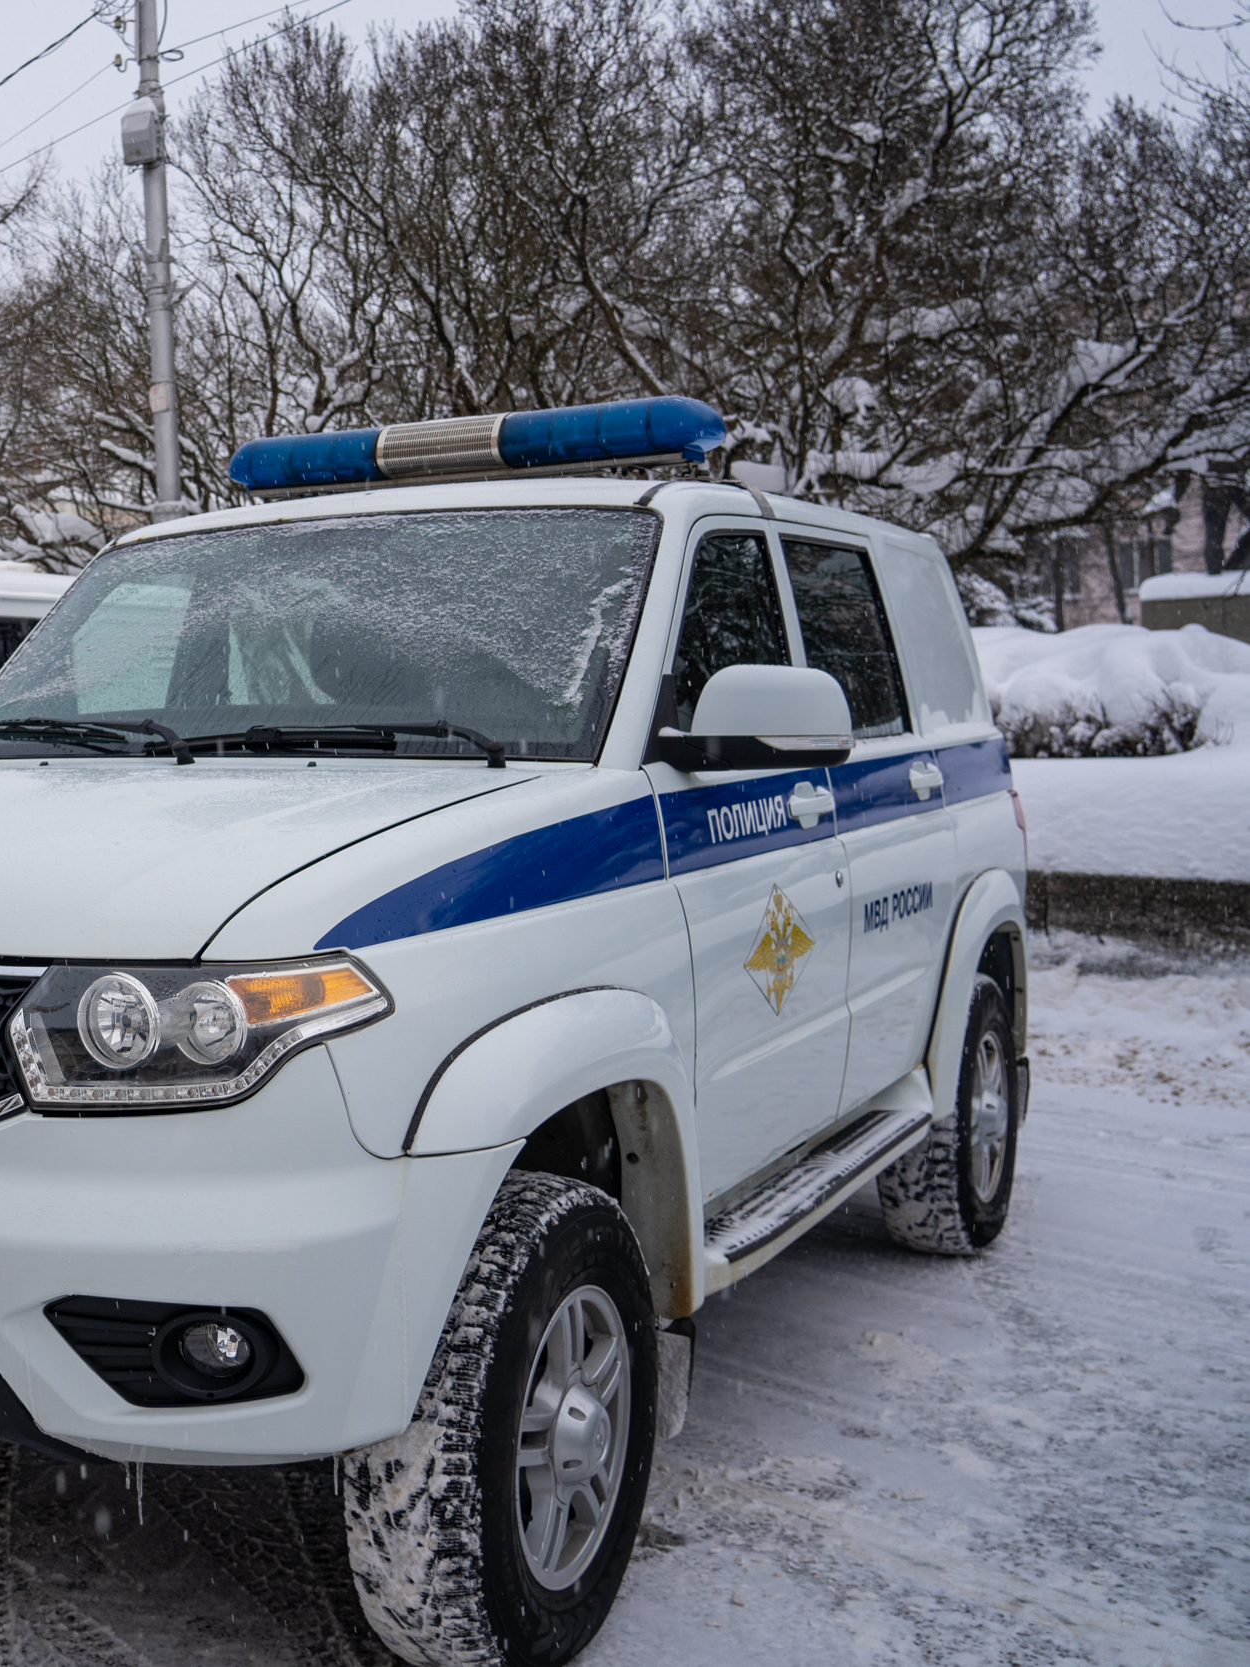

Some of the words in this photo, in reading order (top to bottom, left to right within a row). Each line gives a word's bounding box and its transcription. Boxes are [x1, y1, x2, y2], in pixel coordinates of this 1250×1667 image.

[706, 794, 787, 844] ПОЛИЦИЯ
[863, 897, 889, 934] МВД
[892, 881, 933, 923] РОССИИ
